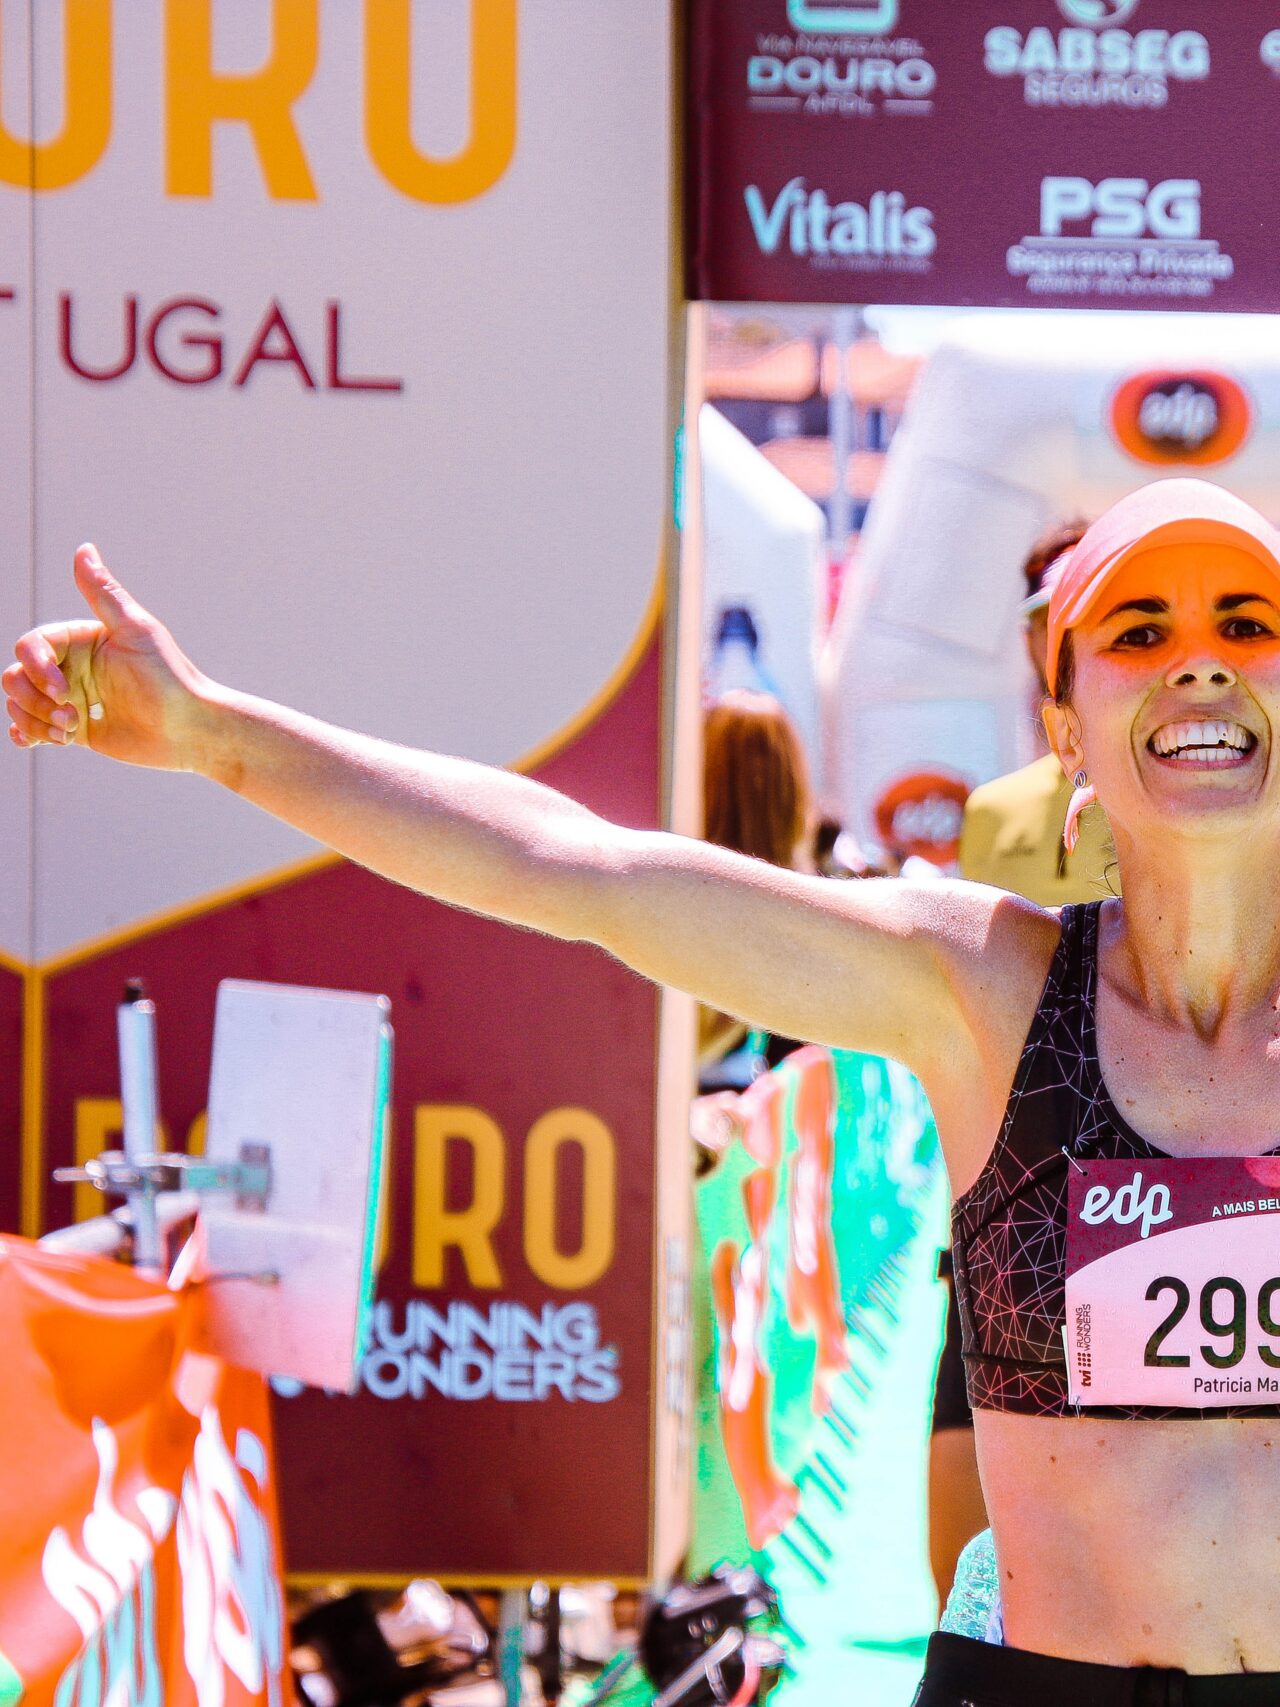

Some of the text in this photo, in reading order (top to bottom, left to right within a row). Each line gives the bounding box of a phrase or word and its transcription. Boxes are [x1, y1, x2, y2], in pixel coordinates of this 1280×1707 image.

[747, 56, 938, 97] DOURO
[983, 26, 1212, 80] SABSEG
[743, 176, 938, 257] Vitalis
[1039, 175, 1201, 239] PSG
[1079, 1172, 1174, 1239] edp
[1211, 1206, 1222, 1218] A
[1223, 1200, 1256, 1216] MAIS
[1075, 1307, 1084, 1348] RUNNING
[1082, 1303, 1091, 1352] WONDERS
[340, 1348, 621, 1402] ONDERS
[1194, 1376, 1252, 1393] Patricia
